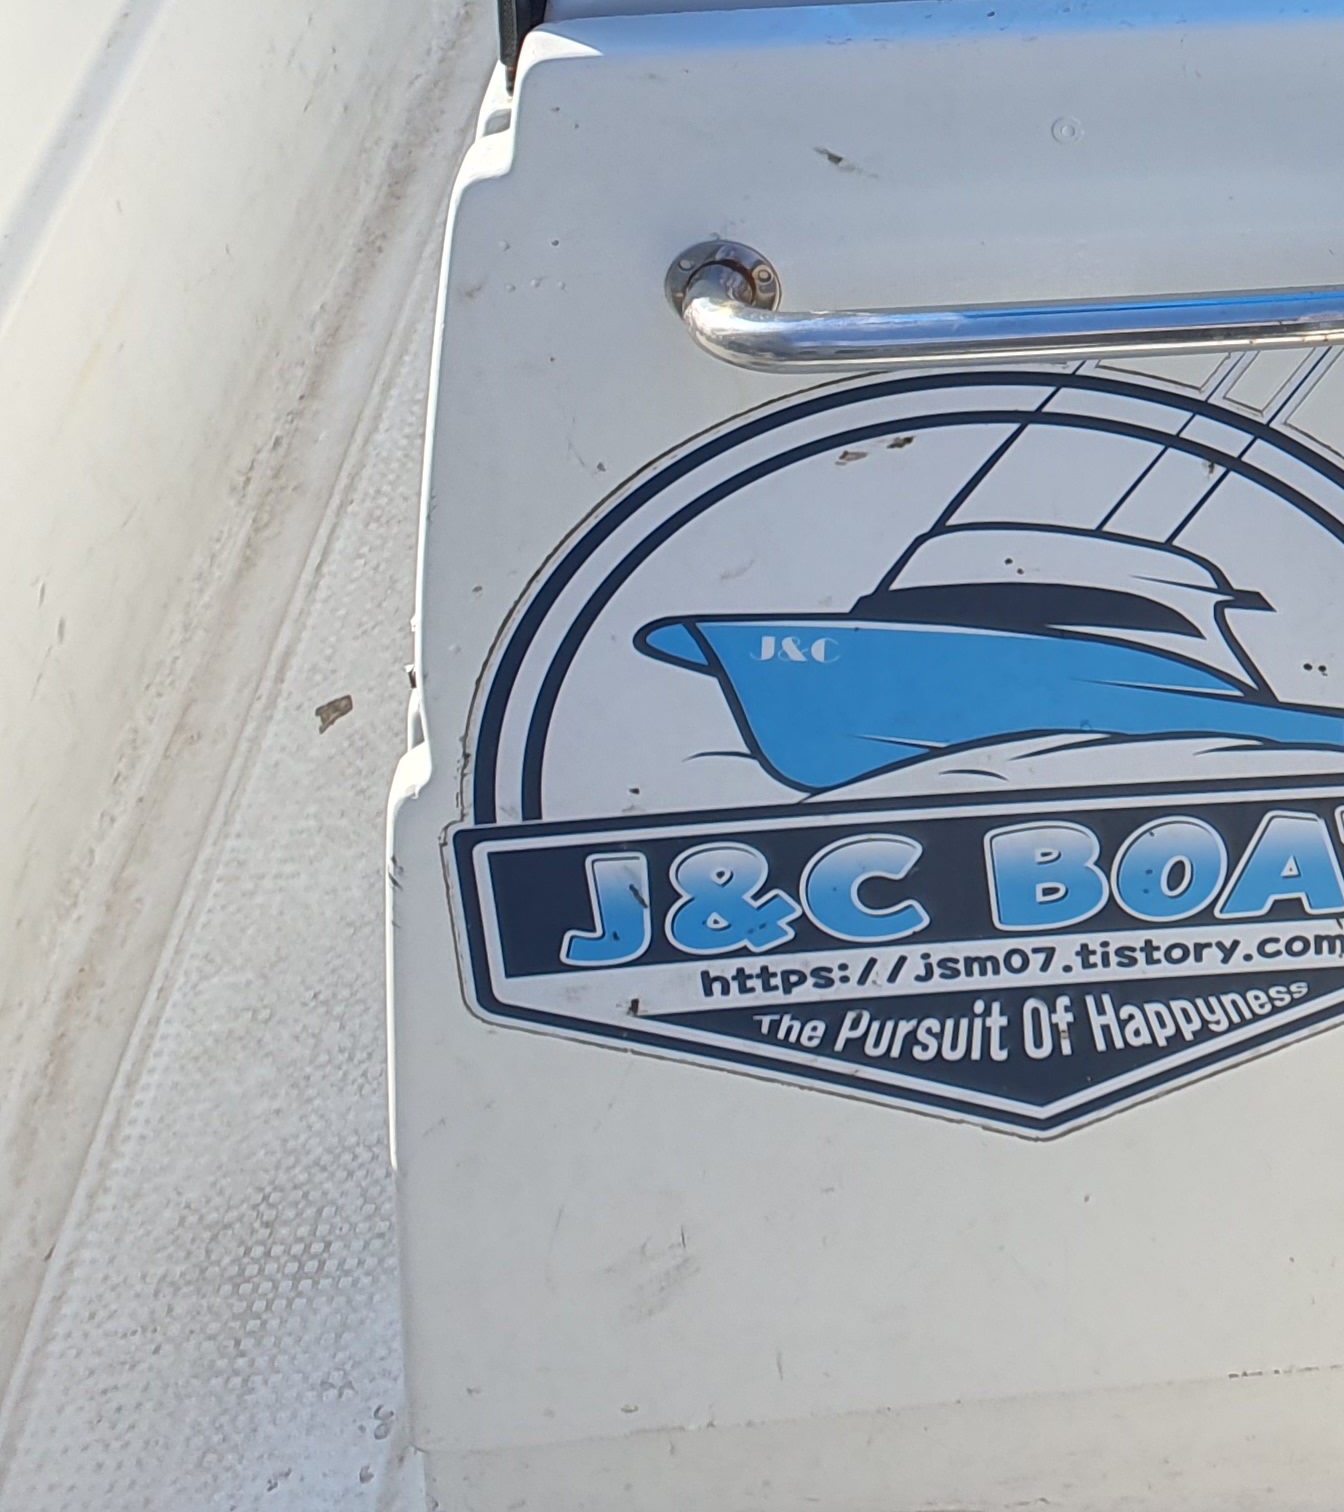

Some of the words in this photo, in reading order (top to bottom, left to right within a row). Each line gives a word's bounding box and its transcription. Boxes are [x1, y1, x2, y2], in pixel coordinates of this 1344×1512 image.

[750, 635, 840, 663] J&C
[559, 833, 931, 967] J&C
[752, 1013, 827, 1049] The
[833, 998, 1010, 1062] Pursuit
[1022, 994, 1075, 1061] Of
[1084, 981, 1310, 1053] Happyness
